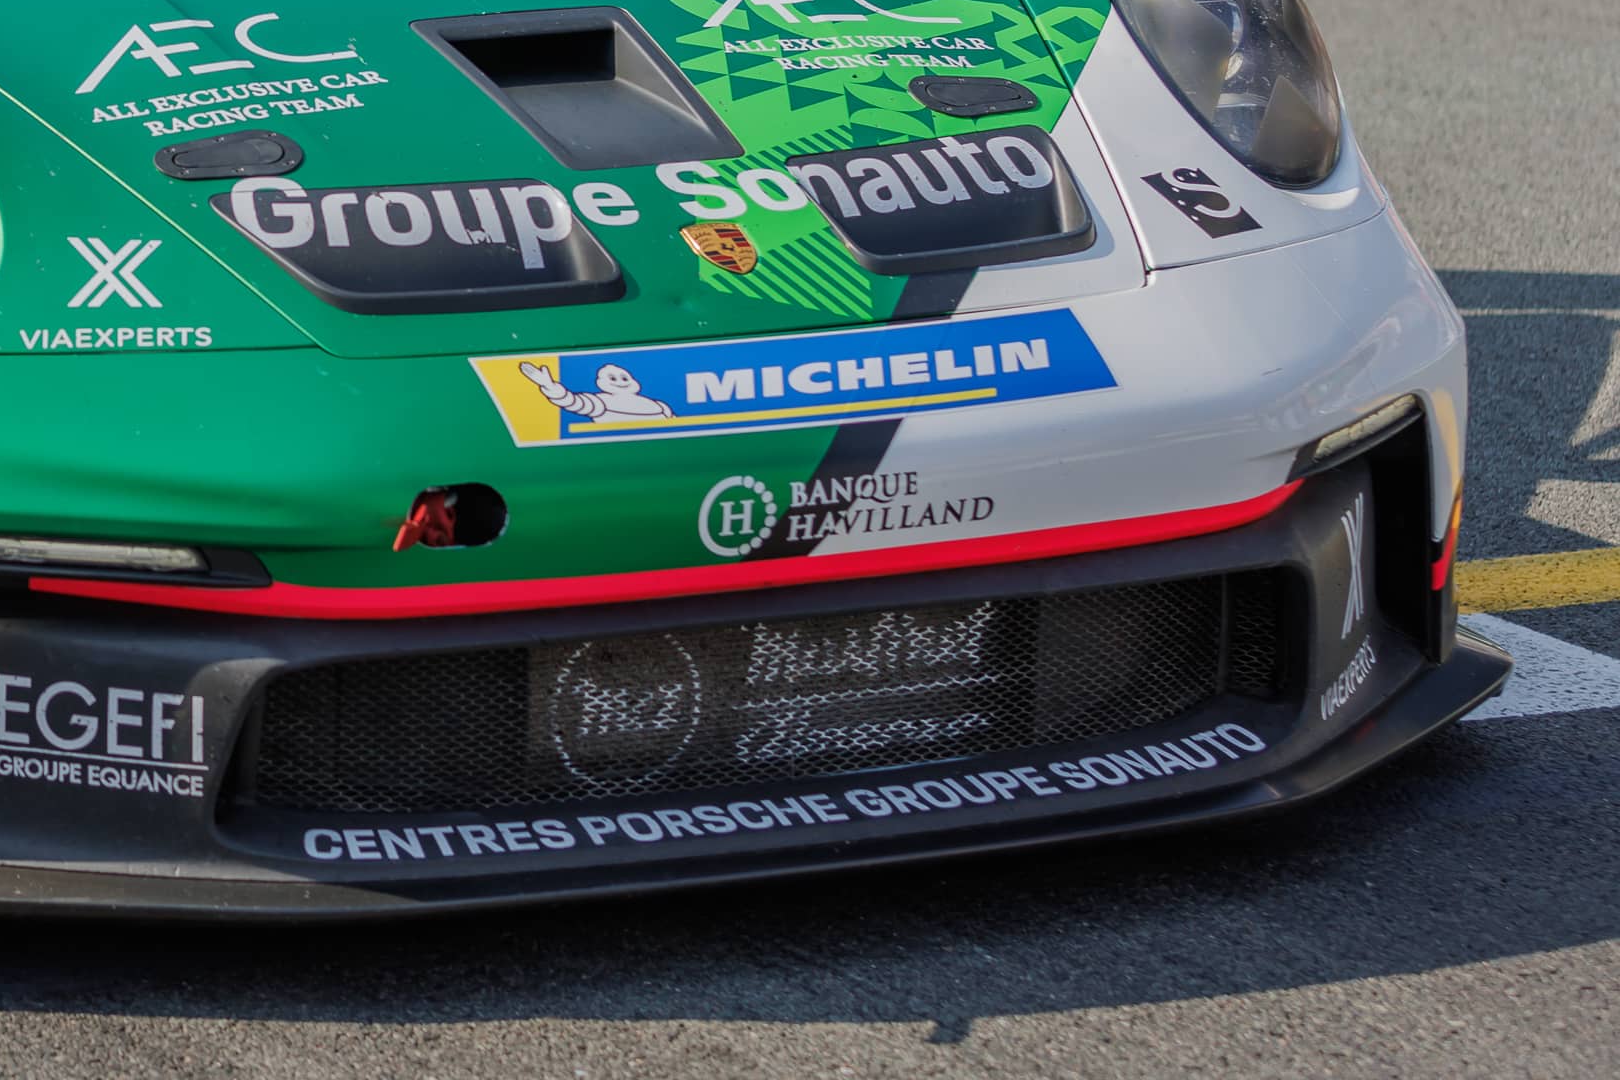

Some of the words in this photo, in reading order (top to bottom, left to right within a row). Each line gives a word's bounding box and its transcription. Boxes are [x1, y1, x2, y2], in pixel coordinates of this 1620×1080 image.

[724, 39, 776, 55] ALL
[779, 35, 932, 53] EXCLUSIVE
[935, 35, 994, 51] CAR
[773, 54, 890, 71] RACING
[891, 52, 975, 70] TEAM
[92, 98, 150, 124] ALL
[152, 77, 307, 114] EXCLUSIVE
[310, 69, 388, 94] CAR
[144, 102, 272, 138] RACING
[277, 92, 364, 118] TEAM
[229, 176, 640, 270] Groupe
[655, 131, 1055, 222] Sonauto
[19, 327, 213, 350] VIAEXPERTS
[686, 338, 1050, 405] MICHELIN
[789, 472, 919, 506] BANQUE
[786, 495, 995, 542] HAVILLAND
[1320, 634, 1376, 721] VIAEXPERTS
[87, 765, 204, 799] EQUANCE
[303, 820, 576, 861] CENTRES
[577, 793, 850, 846] PORSCHE
[844, 766, 1062, 818] GROUPE
[1049, 722, 1267, 789] SONAUTO
